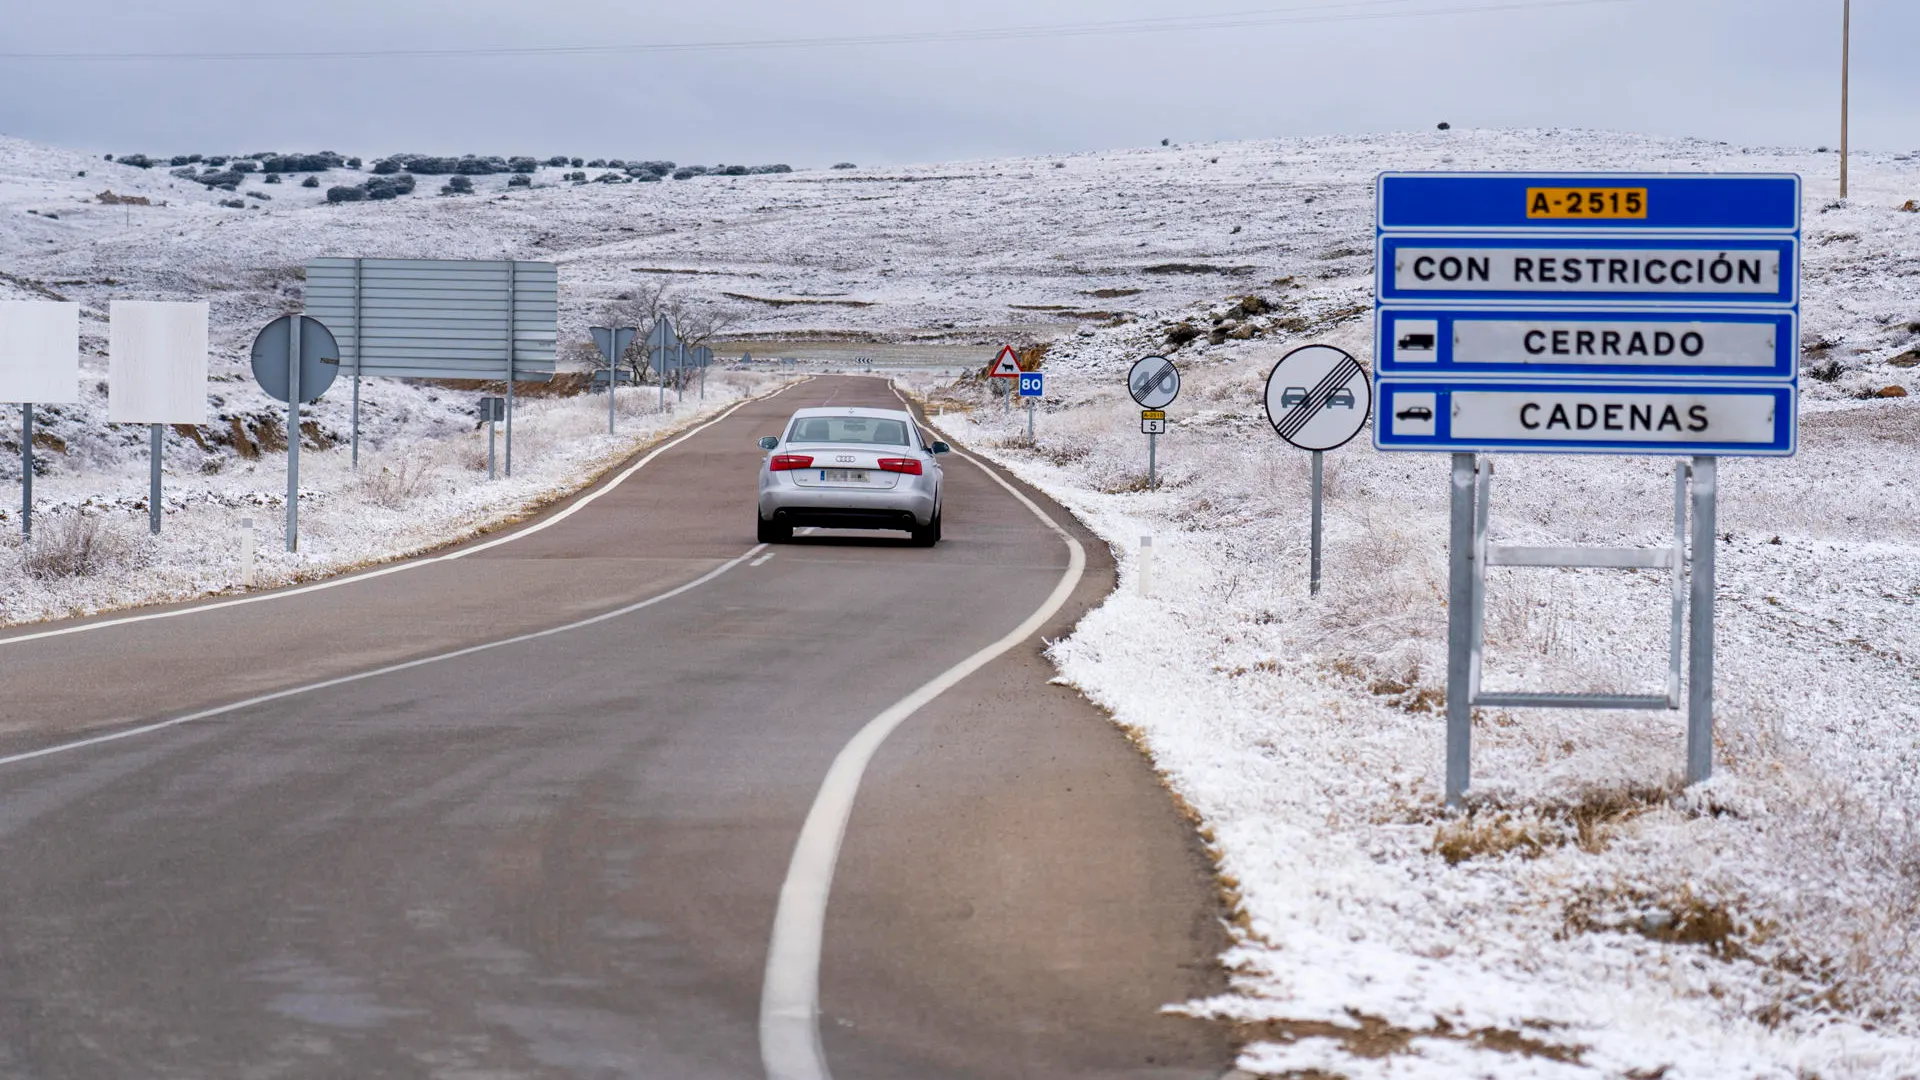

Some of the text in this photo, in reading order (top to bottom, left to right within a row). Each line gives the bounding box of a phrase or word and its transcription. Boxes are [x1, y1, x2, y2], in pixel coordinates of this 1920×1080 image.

[1531, 191, 1642, 214] A-2515
[1413, 252, 1761, 285] CON RESTRICCIÓN
[1523, 329, 1705, 357] CERRADO
[1022, 378, 1041, 390] 80
[1132, 371, 1176, 394] 40
[1150, 421, 1156, 431] 5
[1519, 402, 1709, 433] CADENAS
